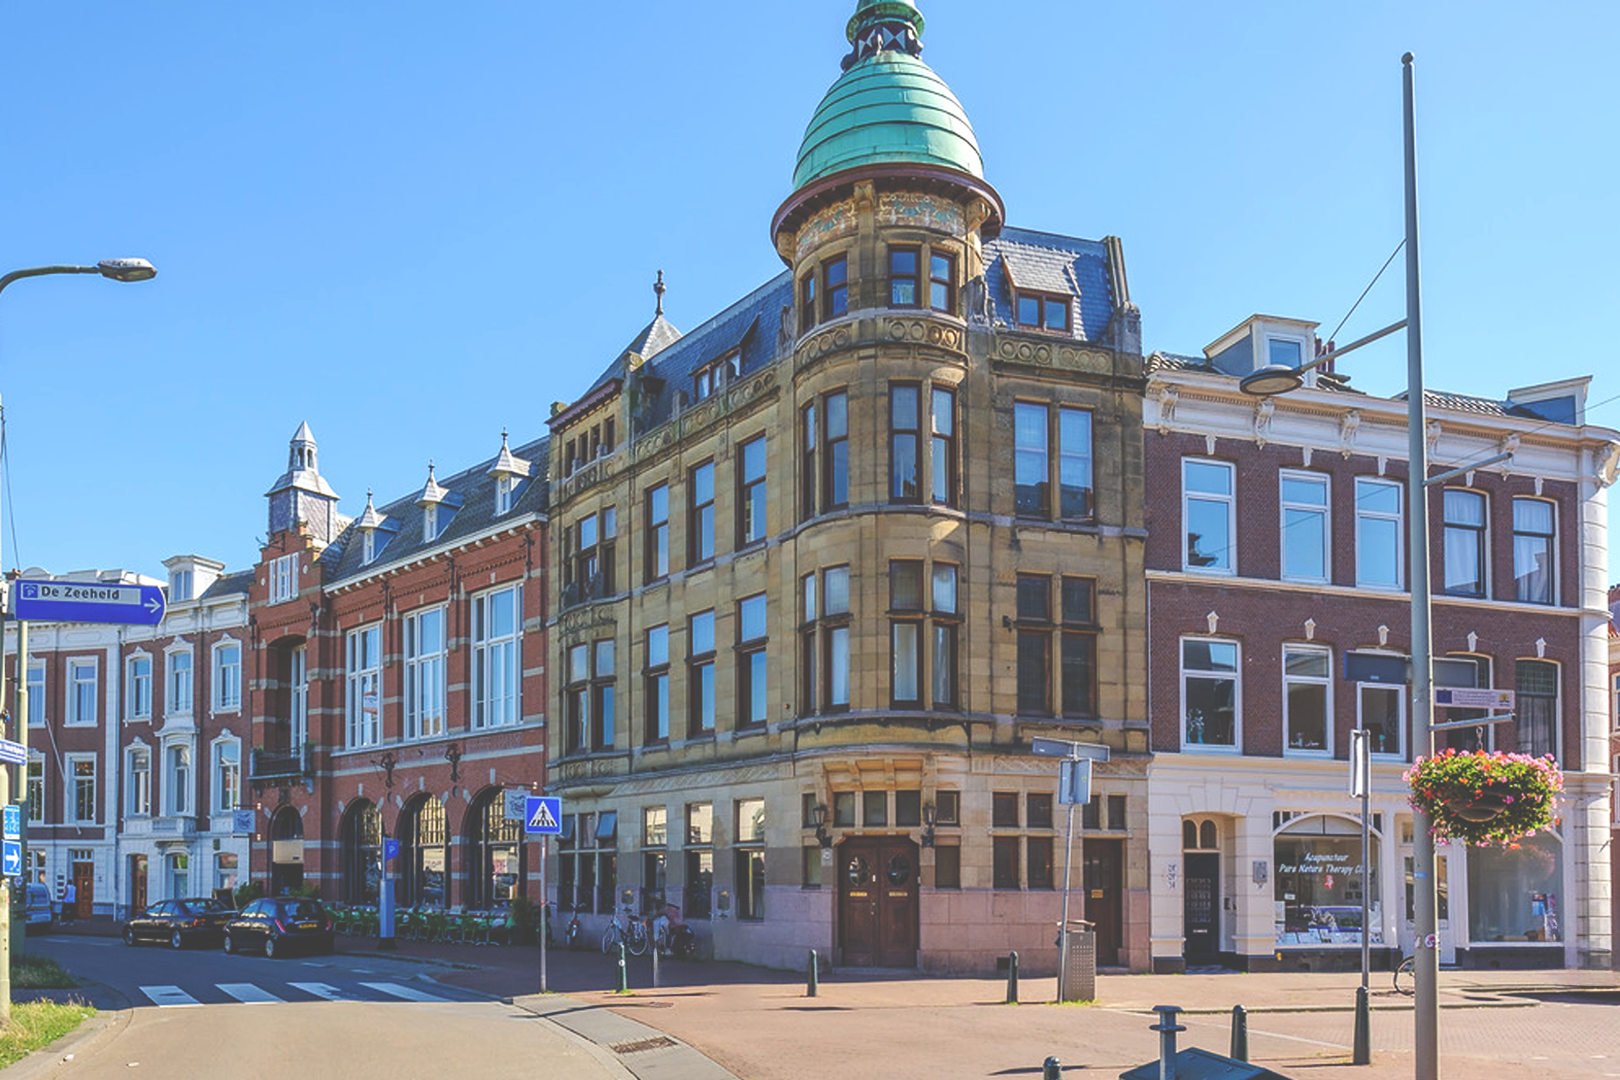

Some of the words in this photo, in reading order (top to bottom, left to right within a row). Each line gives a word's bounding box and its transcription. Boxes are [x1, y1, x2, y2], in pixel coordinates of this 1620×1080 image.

[41, 585, 59, 598] De
[65, 586, 120, 600] Zeeheld
[1279, 863, 1297, 873] Pure
[1299, 863, 1324, 873] Nature
[1325, 863, 1353, 875] Therapy
